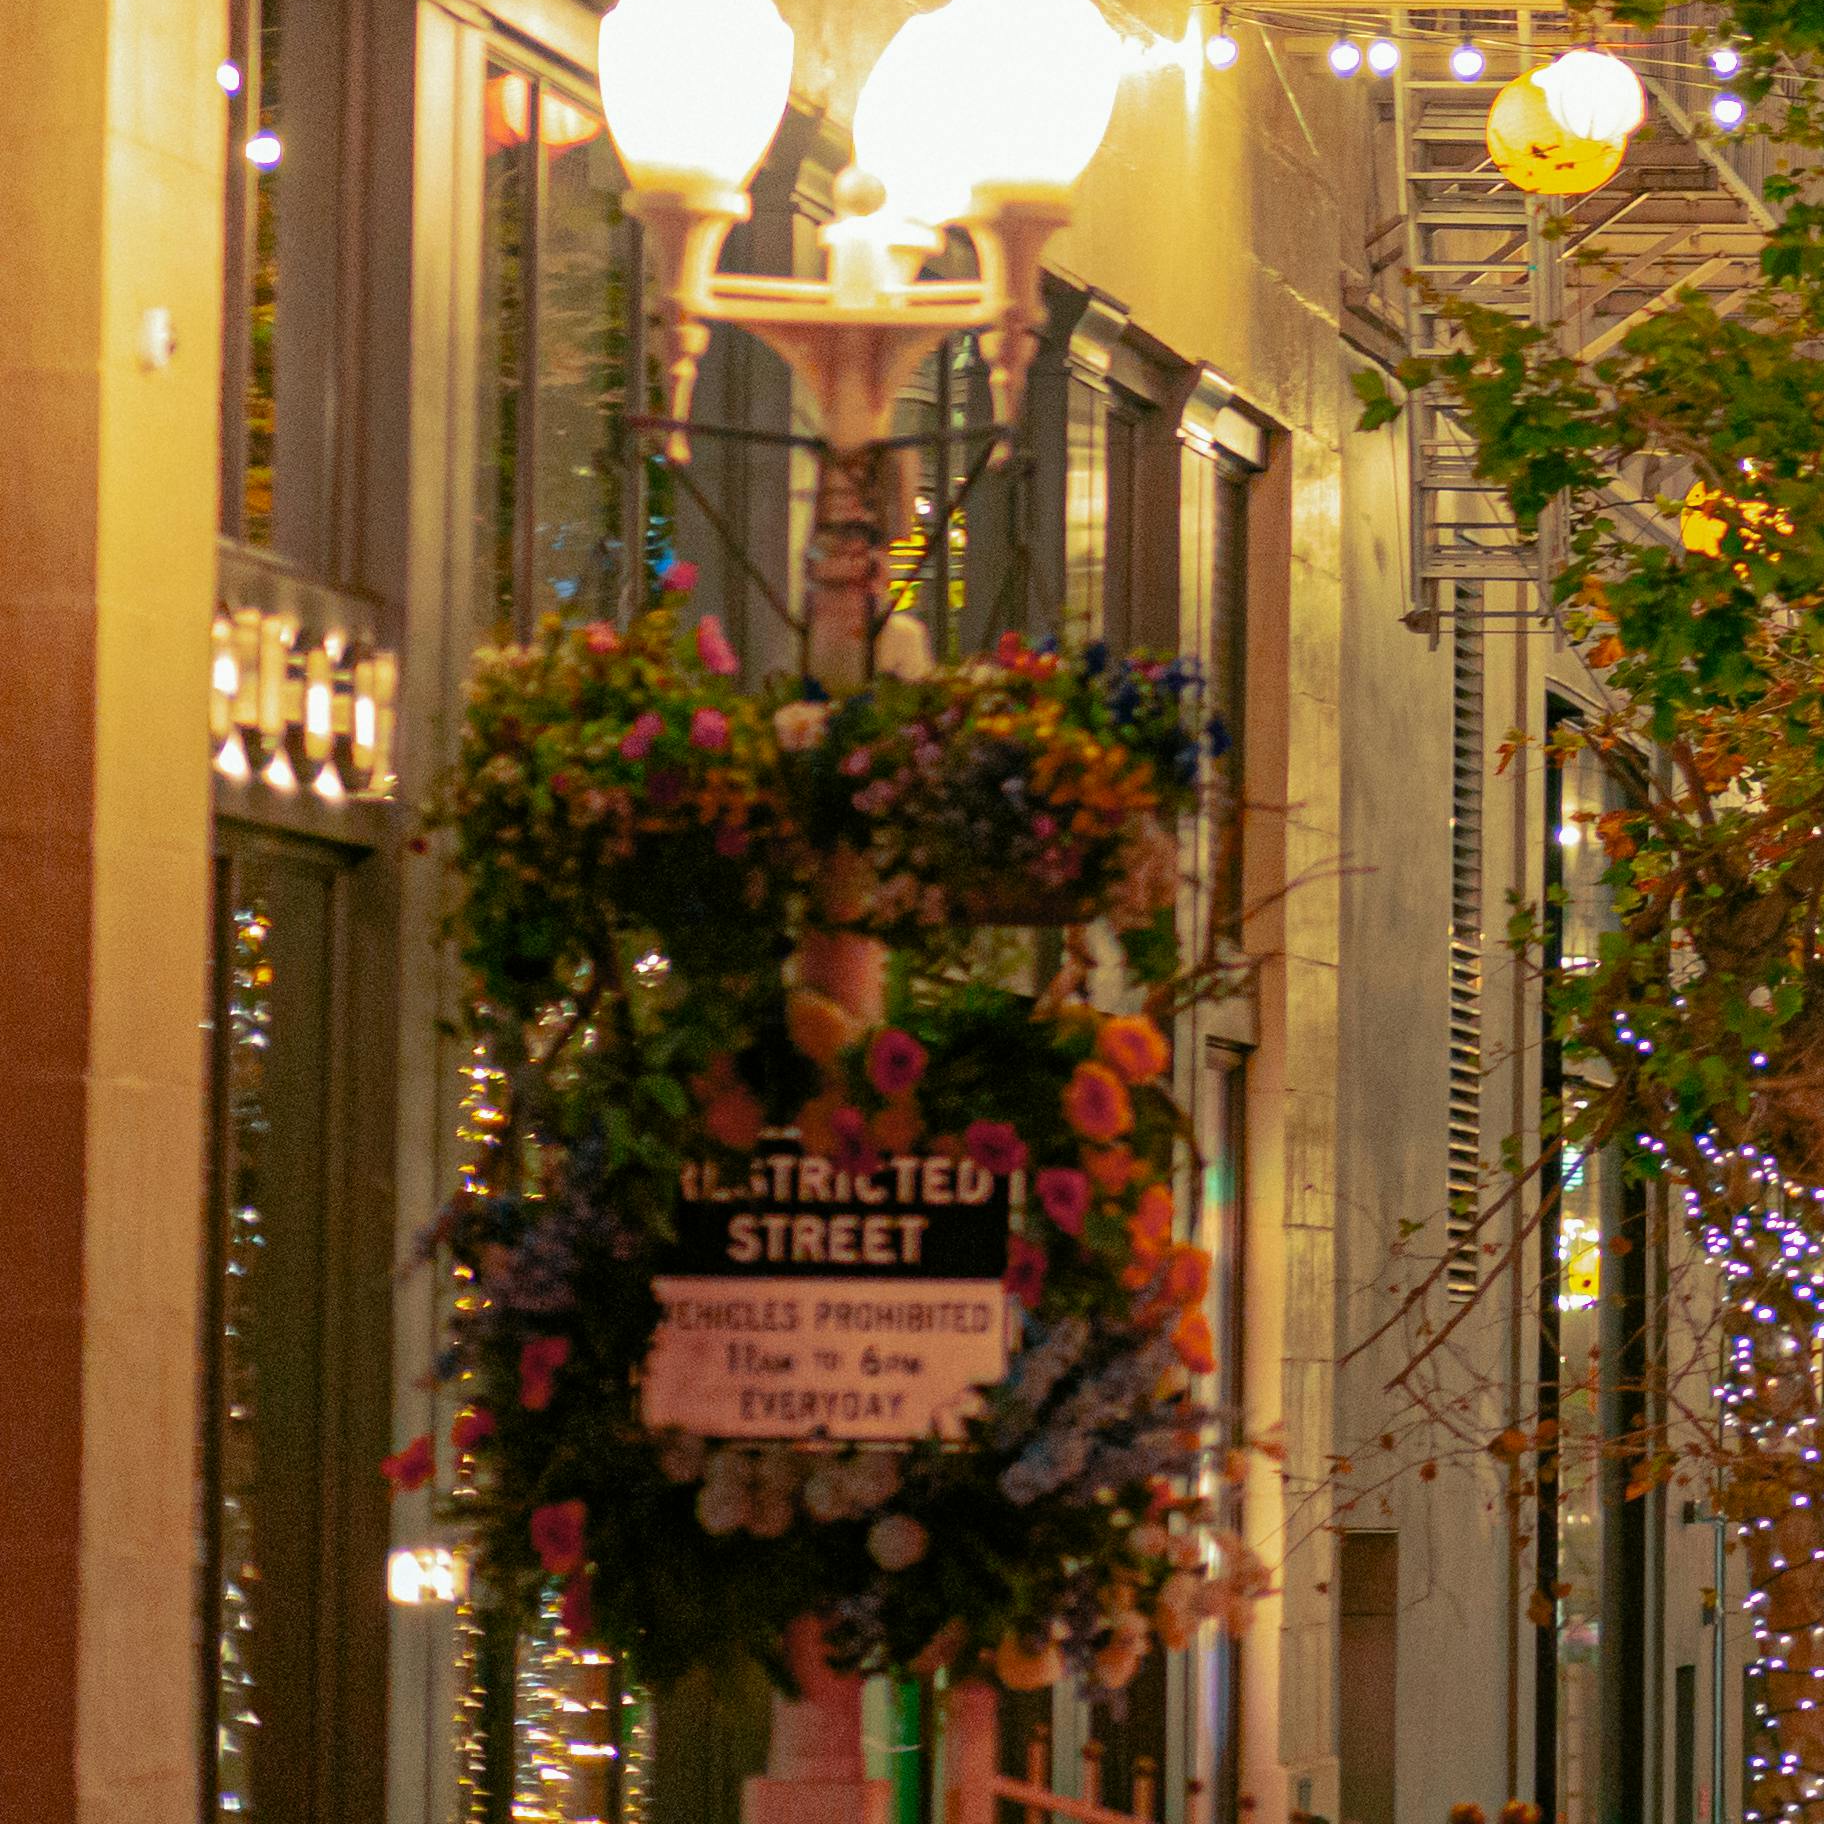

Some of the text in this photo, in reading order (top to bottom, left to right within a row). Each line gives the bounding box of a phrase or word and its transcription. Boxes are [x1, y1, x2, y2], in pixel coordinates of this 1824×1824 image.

[726, 1213, 930, 1265] STREET
[814, 1302, 993, 1333] PROHIBITED
[740, 1389, 908, 1419] EVERYDAY
